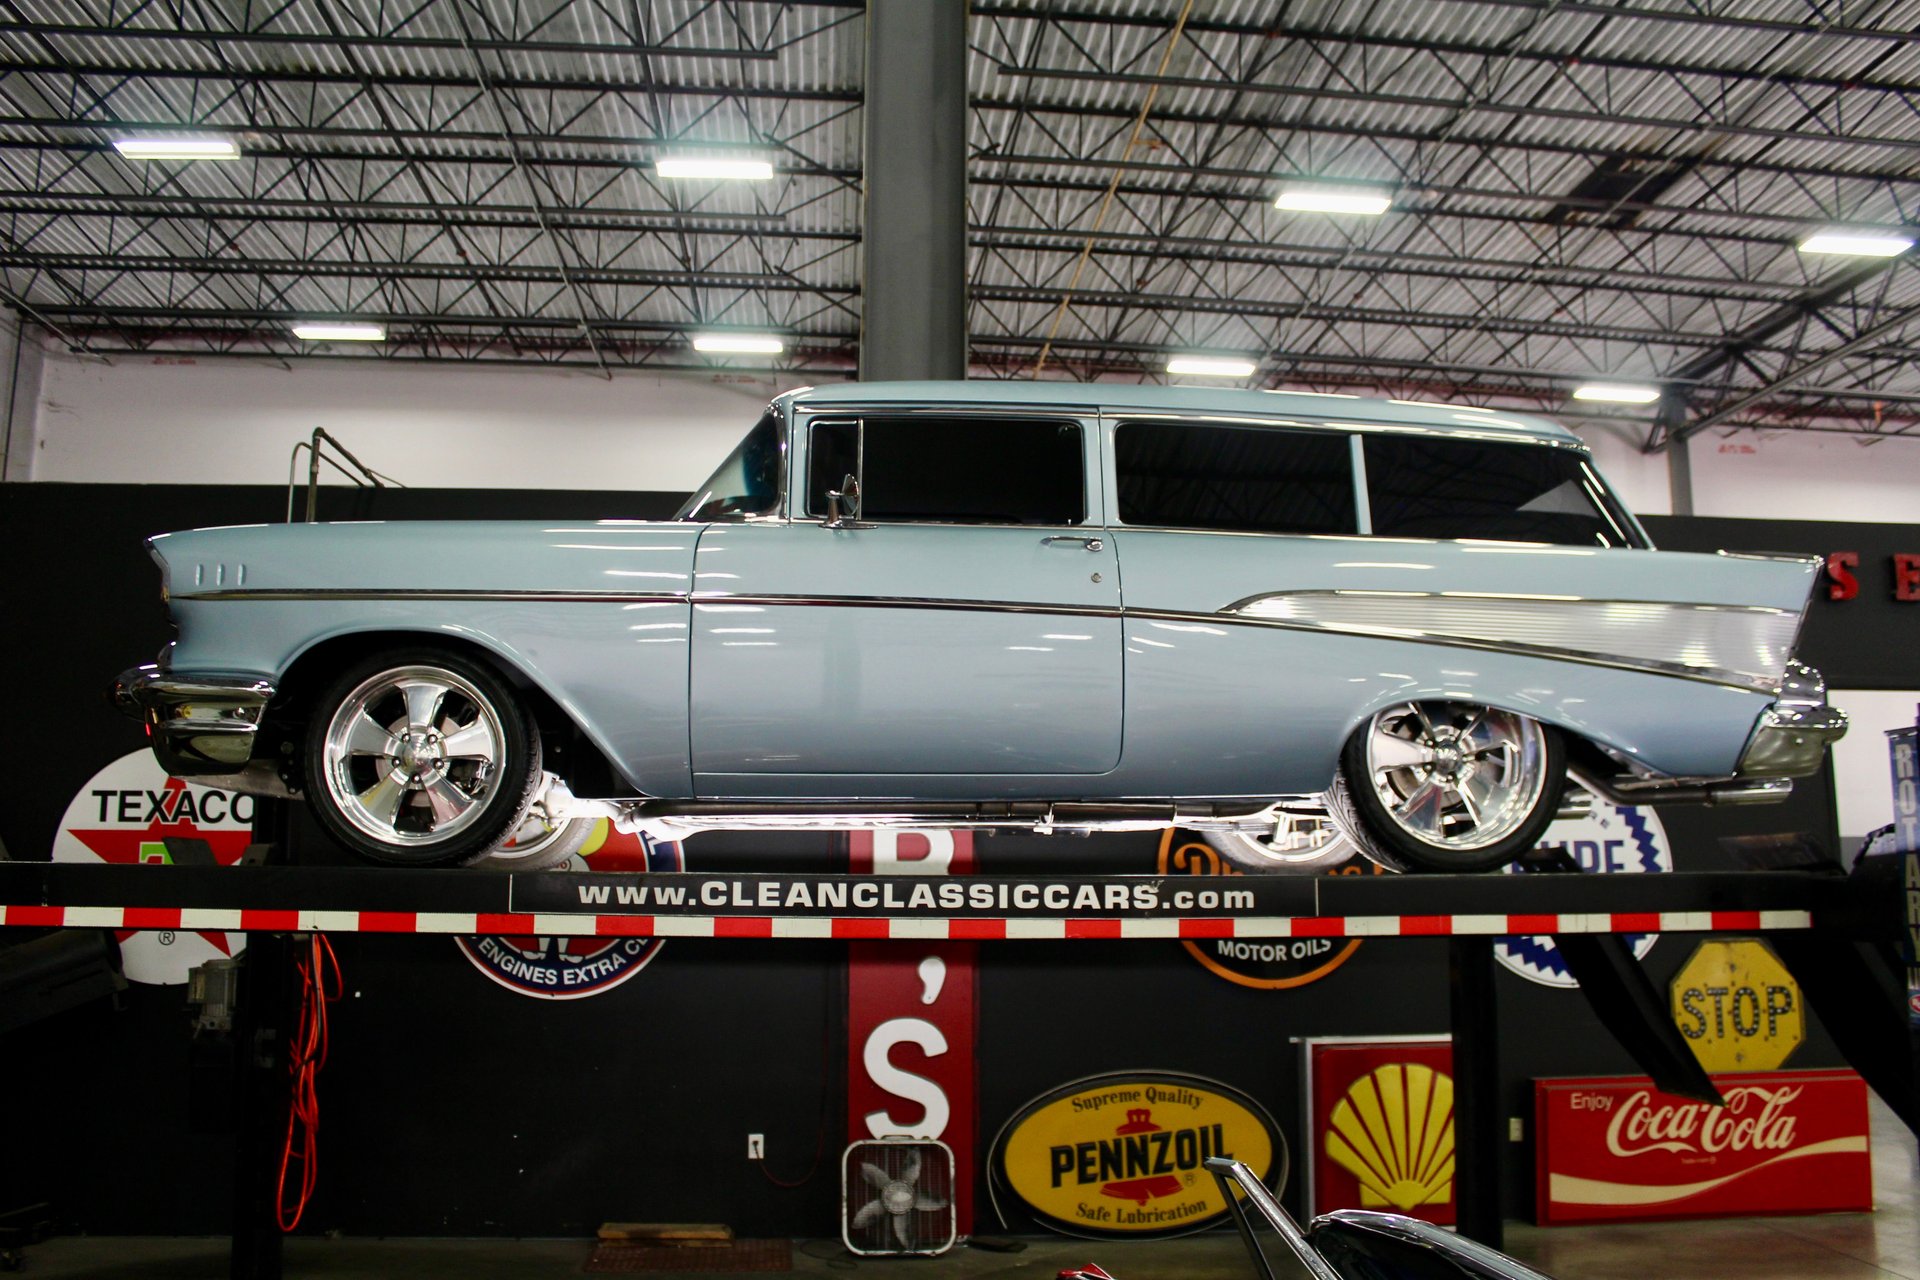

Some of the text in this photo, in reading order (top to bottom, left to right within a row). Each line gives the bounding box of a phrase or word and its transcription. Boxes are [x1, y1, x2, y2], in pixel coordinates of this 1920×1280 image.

[92, 789, 254, 824] TEXACO
[578, 881, 1255, 910] www.CLEANCLASSICCARS.com
[478, 937, 558, 985] ENGINES
[563, 954, 627, 985] EXTRA
[1217, 938, 1332, 962] MOTOR OILS
[1681, 986, 1793, 1039] STOP
[1071, 1086, 1204, 1113] Supreme Quality
[1570, 1092, 1614, 1112] Enjoy
[1050, 1123, 1234, 1188] PENNZOIL
[1076, 1200, 1207, 1224] Safe Lubrication
